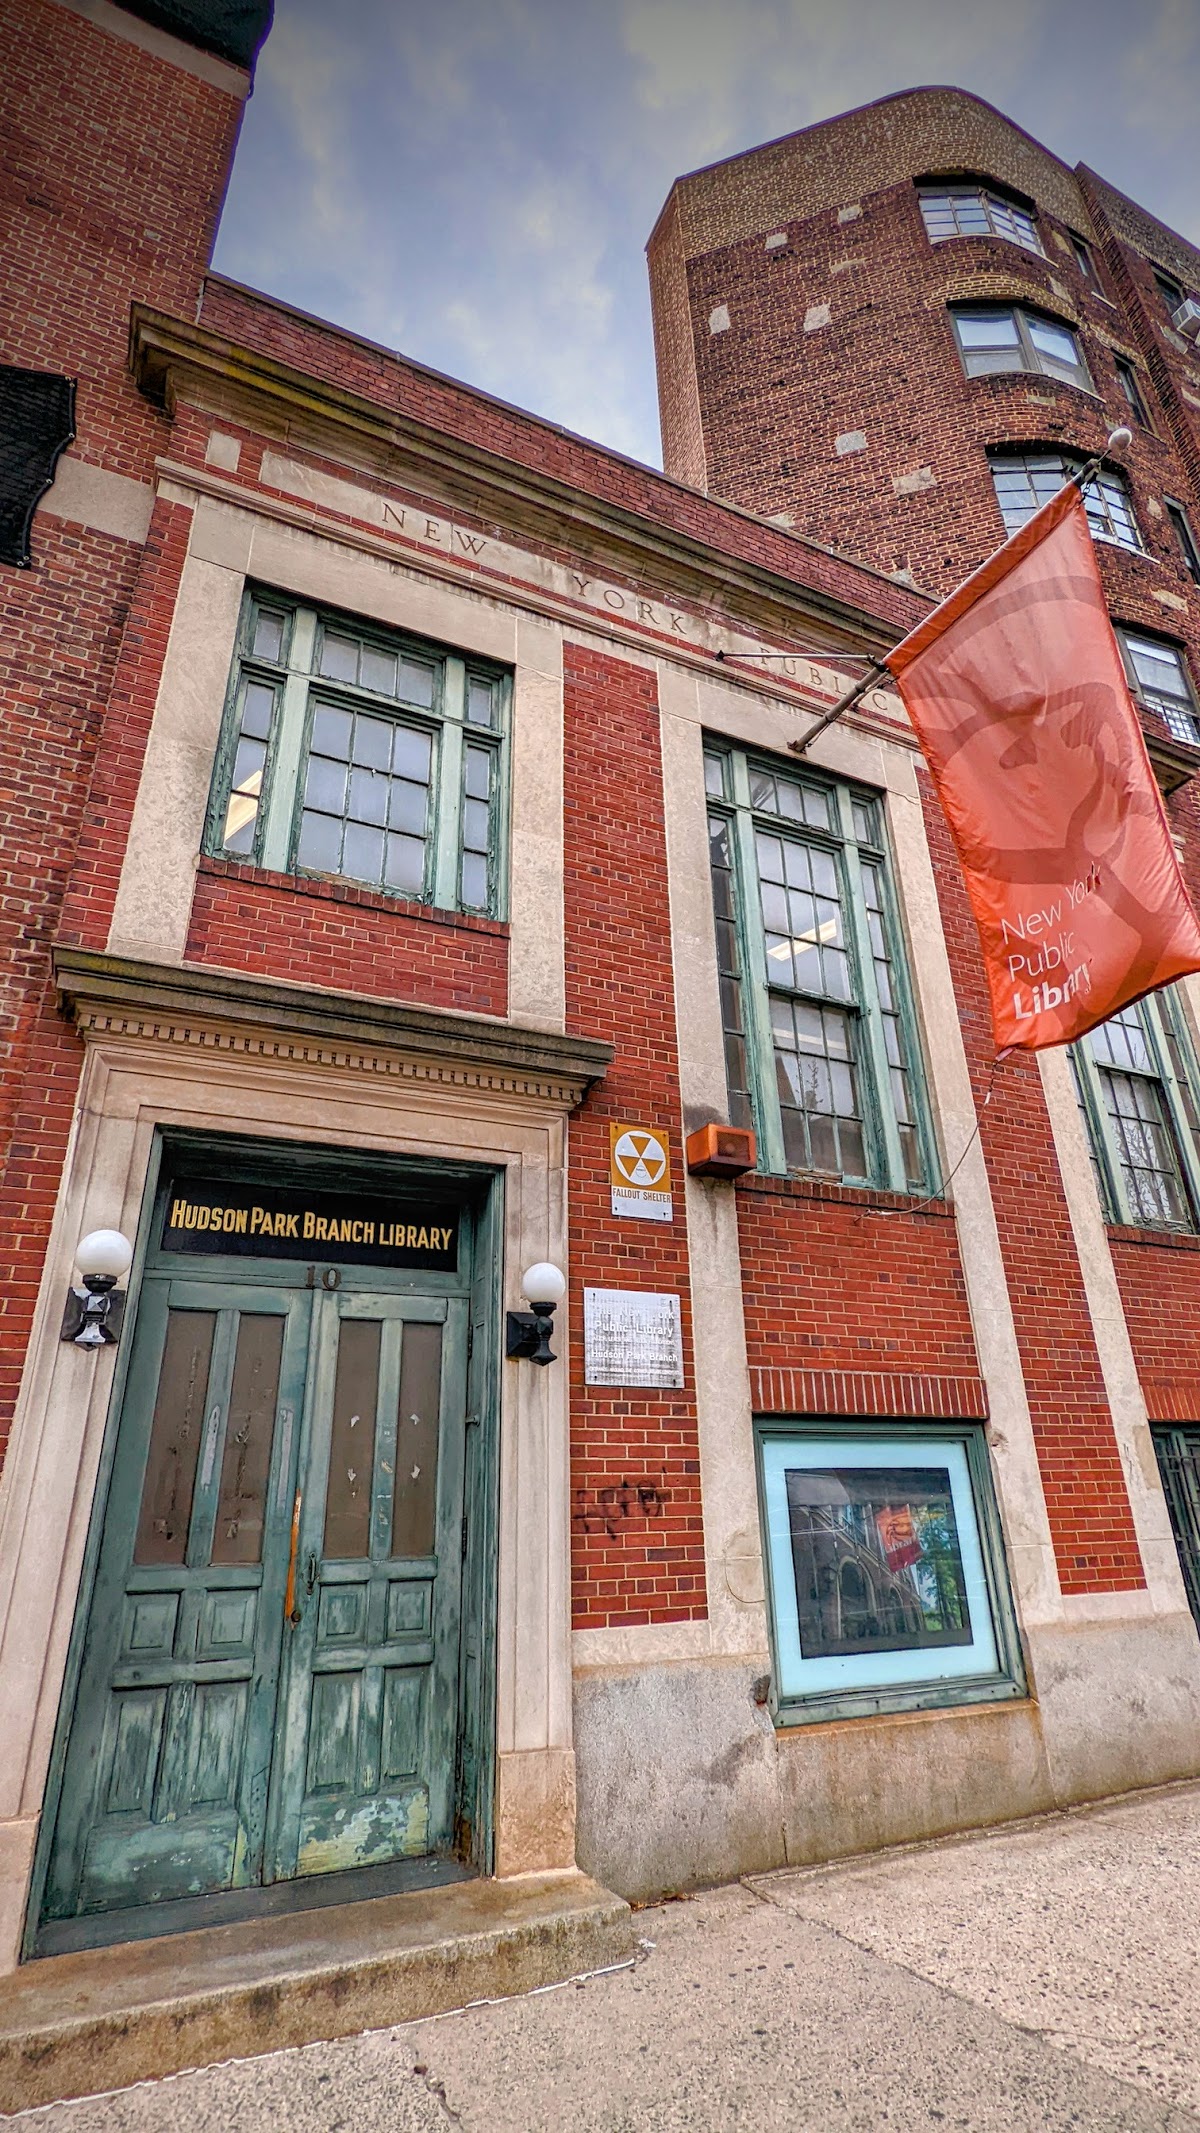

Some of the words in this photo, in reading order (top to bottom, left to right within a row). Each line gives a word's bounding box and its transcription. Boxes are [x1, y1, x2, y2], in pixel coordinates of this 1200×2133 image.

[381, 501, 488, 556] NEW
[571, 575, 687, 634] YORK
[759, 646, 888, 711] PUBLC
[1001, 899, 1062, 945] New
[1065, 861, 1101, 910] York
[1008, 931, 1075, 982] Public
[612, 1187, 640, 1199] FALLOUT
[643, 1191, 671, 1203] SHELTER
[170, 1199, 248, 1233] HUDSON
[250, 1206, 300, 1238] PARK
[303, 1211, 375, 1244] BRANCH
[379, 1222, 453, 1250] LIBRARY
[305, 1265, 342, 1290] 10
[594, 1320, 629, 1333] Public
[636, 1323, 673, 1338] Library
[591, 1349, 624, 1359] Hudson
[626, 1351, 647, 1361] Park
[649, 1352, 678, 1362] Branch
